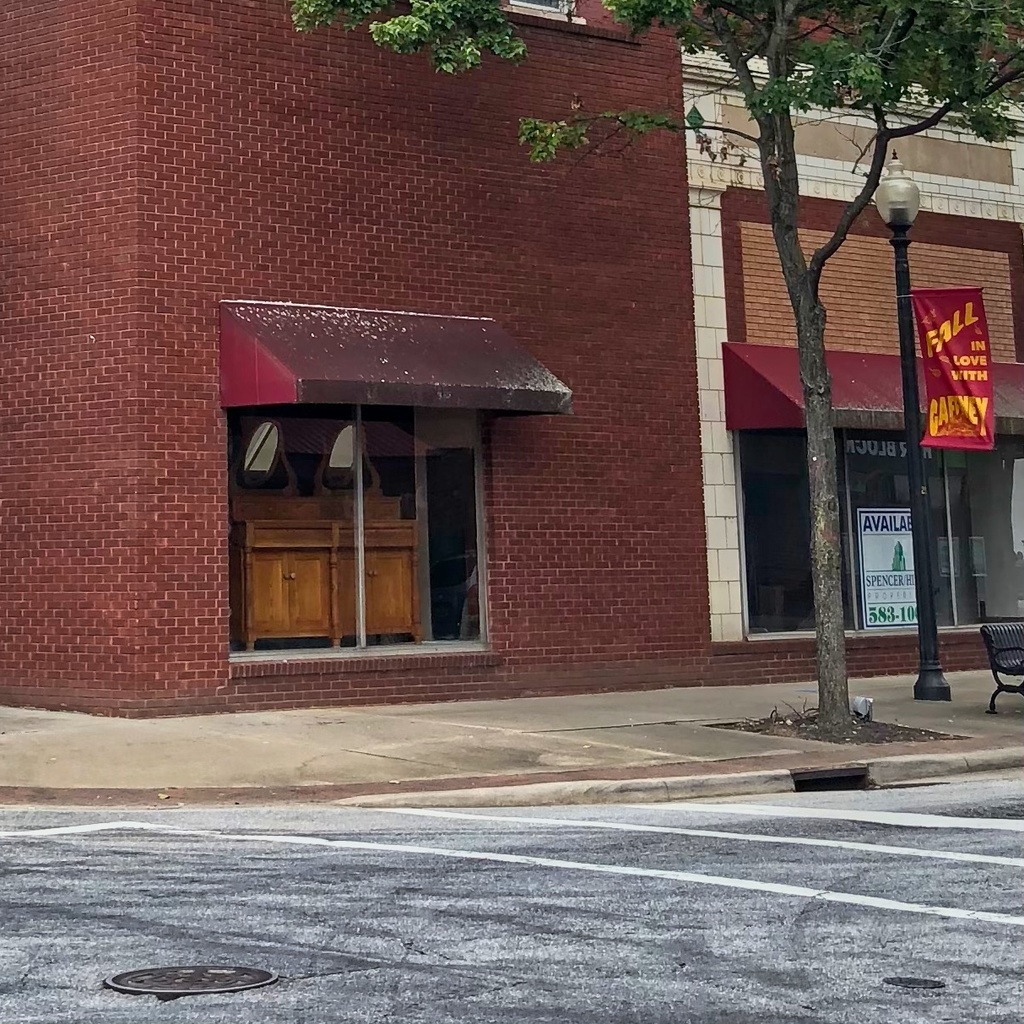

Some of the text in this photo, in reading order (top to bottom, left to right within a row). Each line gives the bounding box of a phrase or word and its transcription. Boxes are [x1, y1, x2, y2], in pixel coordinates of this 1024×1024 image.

[926, 302, 979, 358] FALL
[970, 340, 986, 352] IN
[953, 355, 988, 366] LOVE
[951, 370, 988, 381] WITH
[929, 396, 989, 437] GAFFNEY
[868, 606, 917, 624] 583-10
